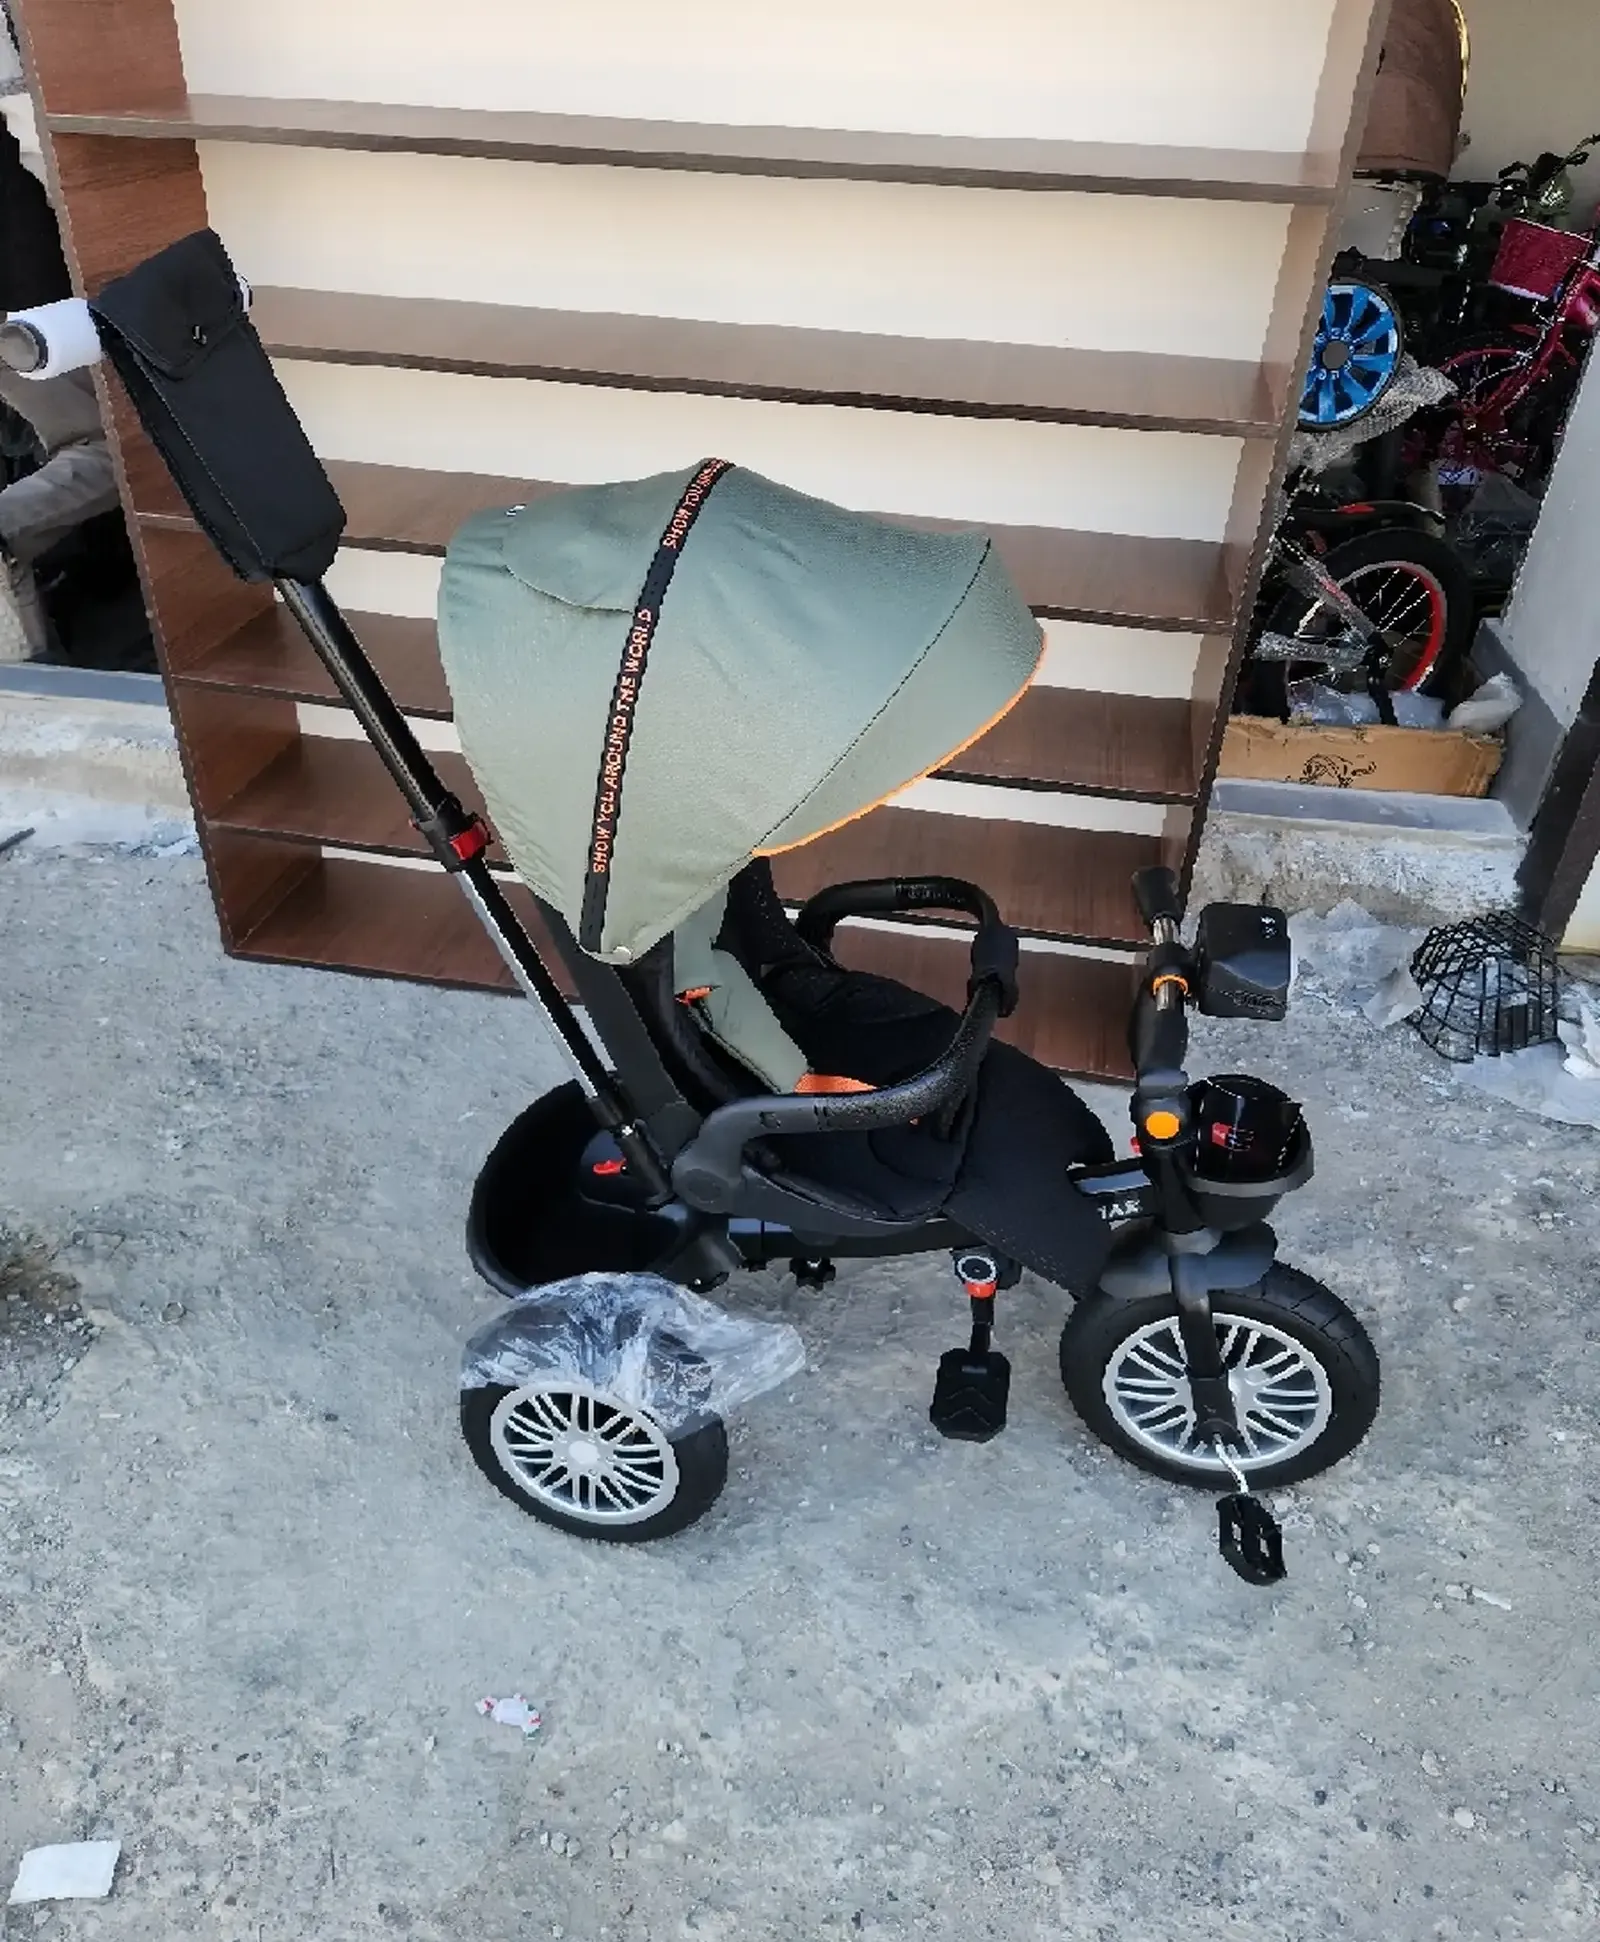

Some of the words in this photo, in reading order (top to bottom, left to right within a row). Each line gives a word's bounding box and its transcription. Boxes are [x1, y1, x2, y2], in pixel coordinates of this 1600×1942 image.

[662, 508, 692, 549] SHOW
[624, 608, 653, 673] WORLD
[616, 676, 637, 711] THE
[603, 714, 628, 789] AROUND
[599, 789, 616, 823] YOU
[593, 827, 611, 873] SHOW
